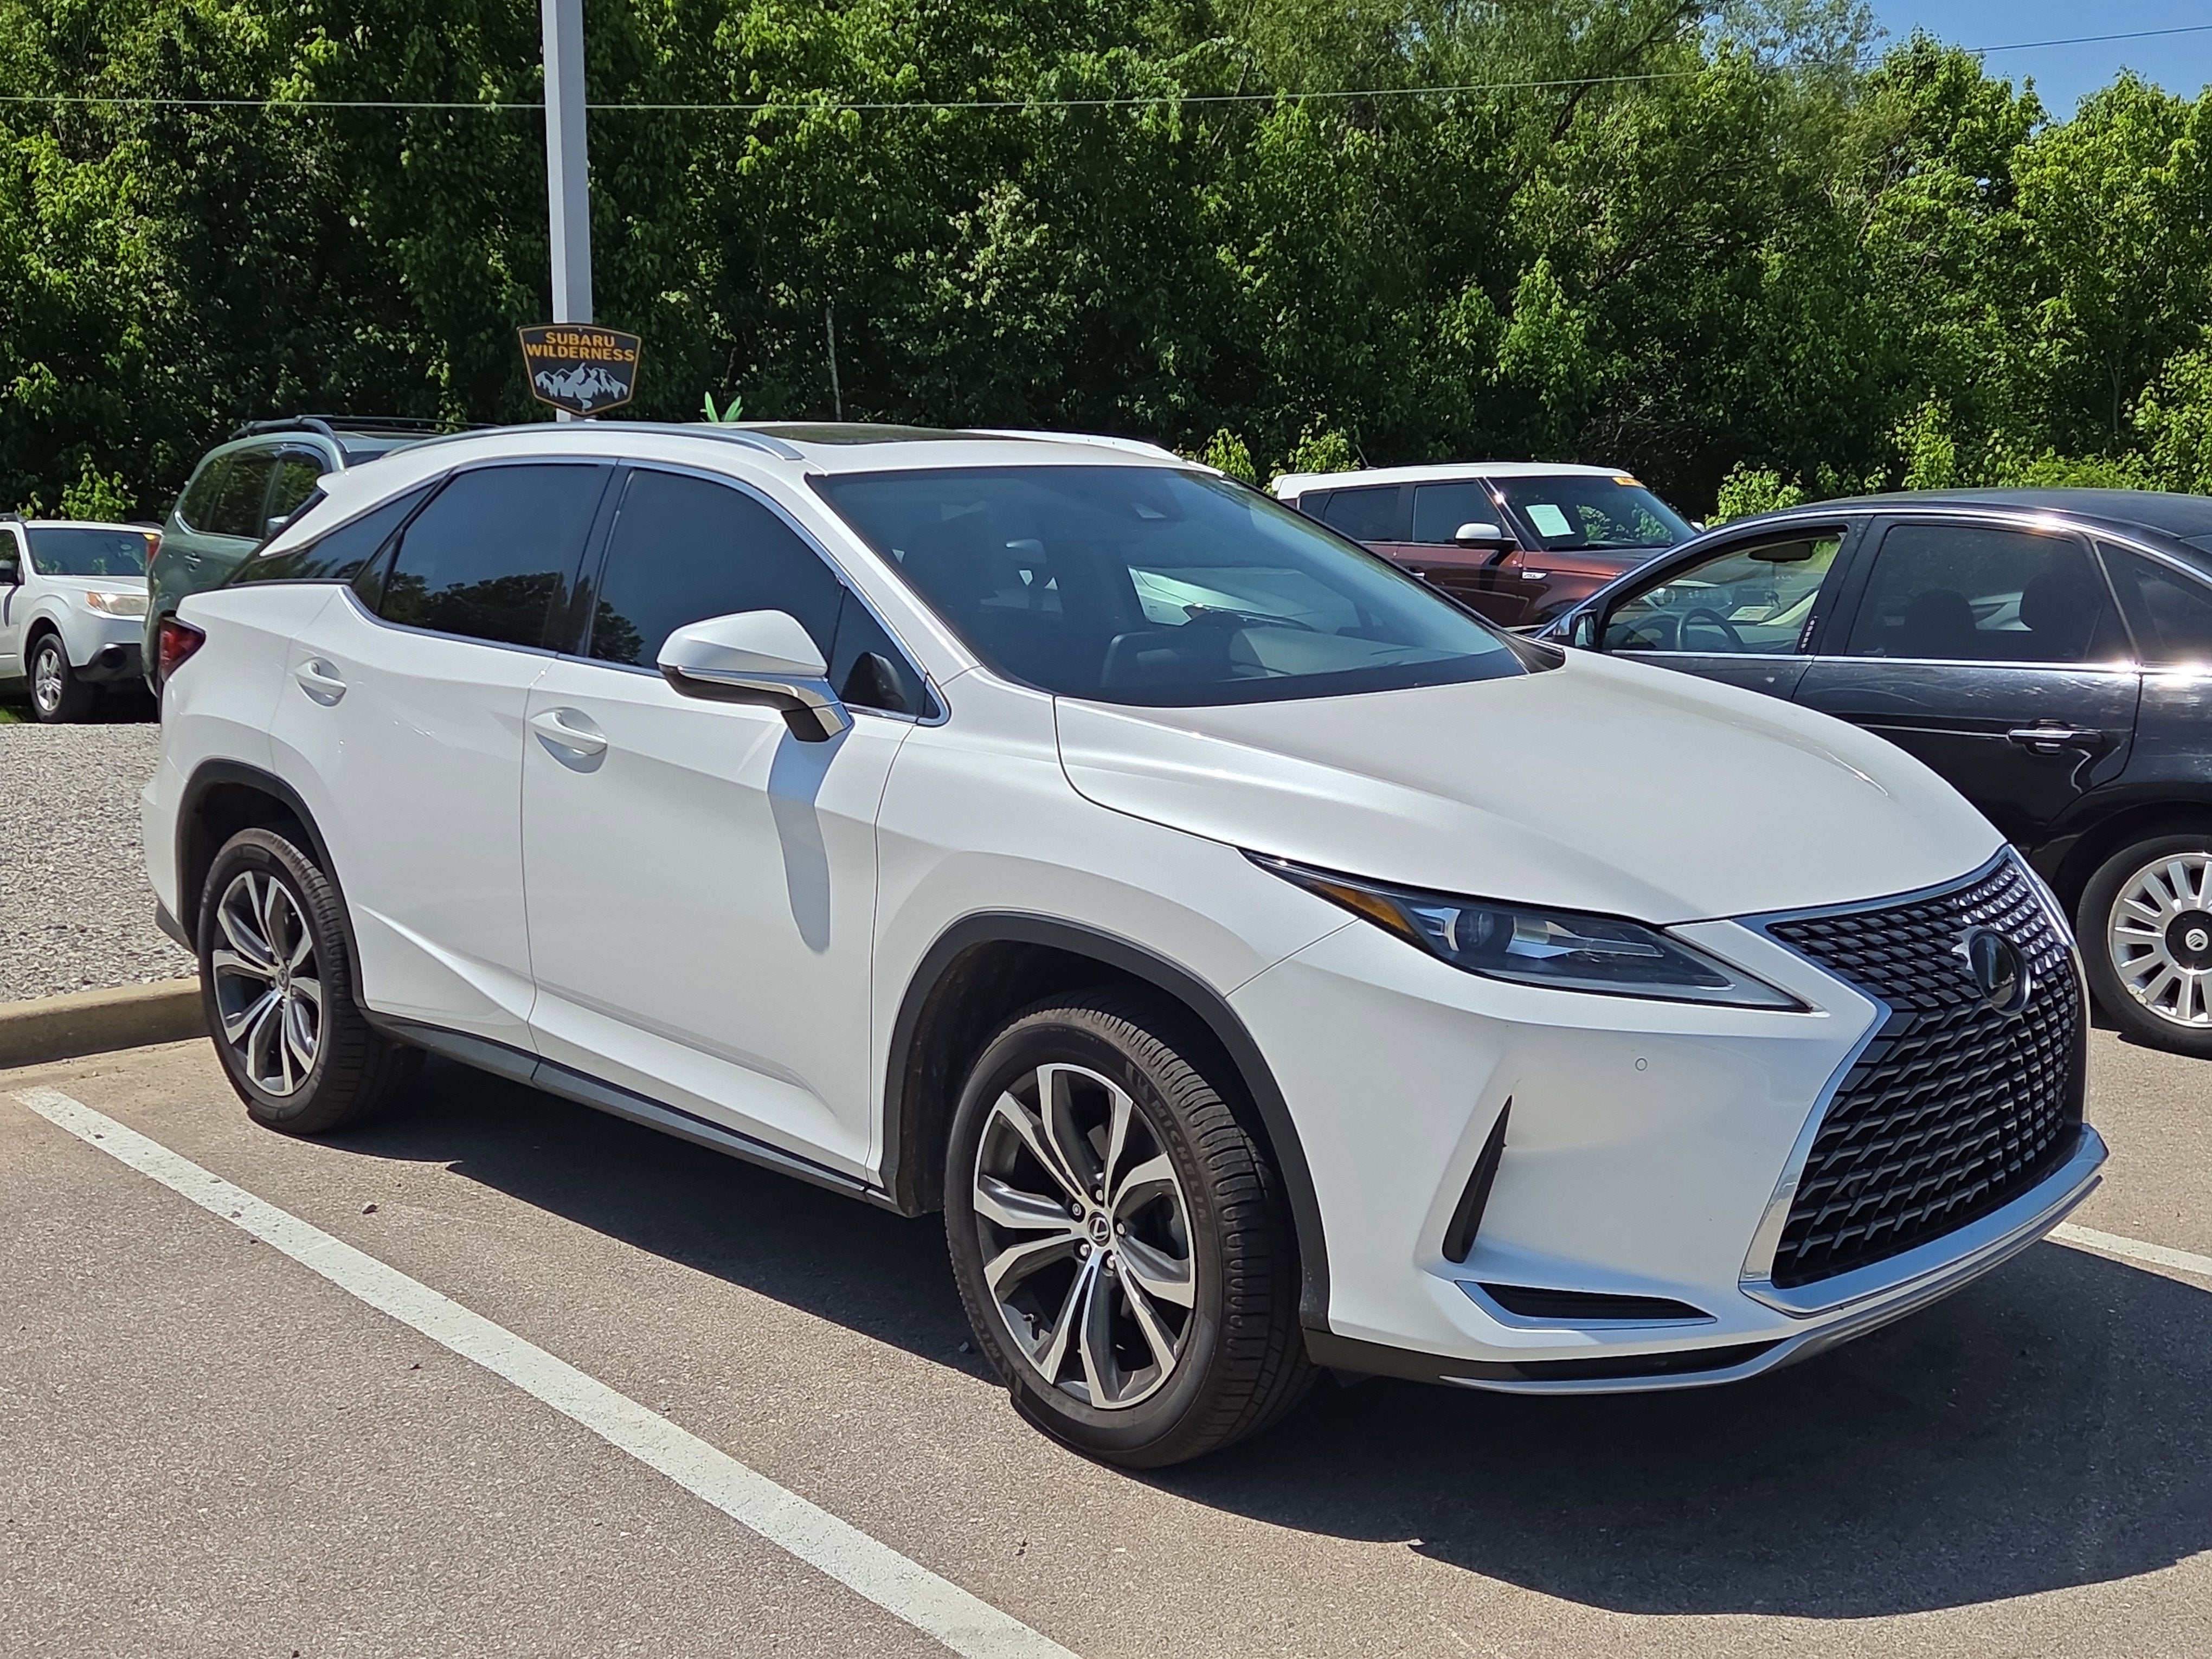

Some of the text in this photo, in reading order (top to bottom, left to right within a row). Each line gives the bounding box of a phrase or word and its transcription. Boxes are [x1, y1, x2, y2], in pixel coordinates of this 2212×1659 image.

[545, 332, 615, 347] SUBARU
[526, 344, 635, 361] WILDERNESS
[1151, 1099, 1207, 1223] MICHELIN
